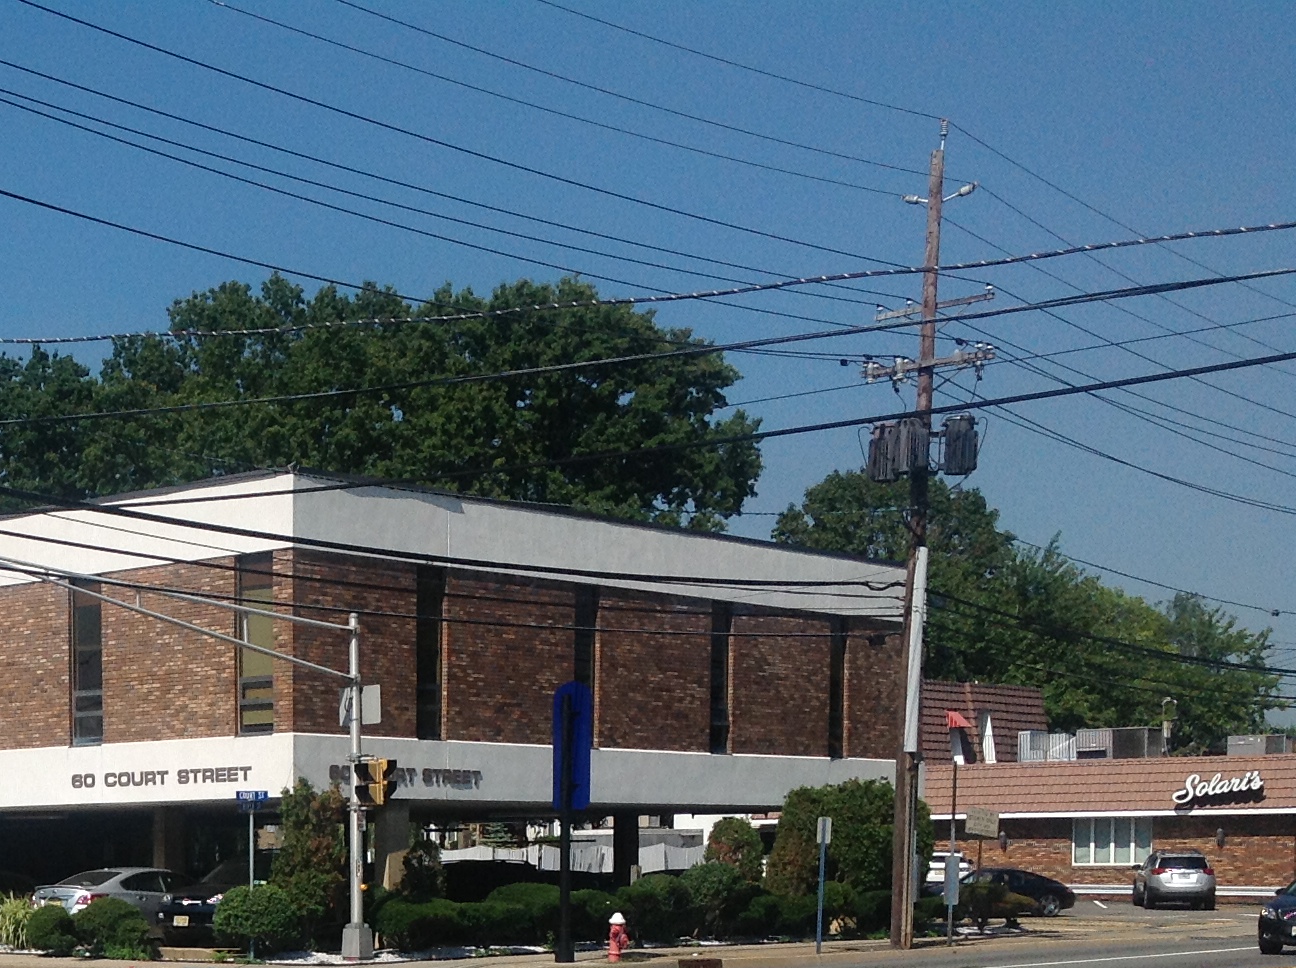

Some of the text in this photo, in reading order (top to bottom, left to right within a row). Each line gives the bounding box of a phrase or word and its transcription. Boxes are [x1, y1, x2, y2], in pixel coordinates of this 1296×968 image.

[71, 766, 252, 789] 60 COURT STREET
[422, 768, 482, 789] STREET
[1172, 771, 1264, 803] Solari's
